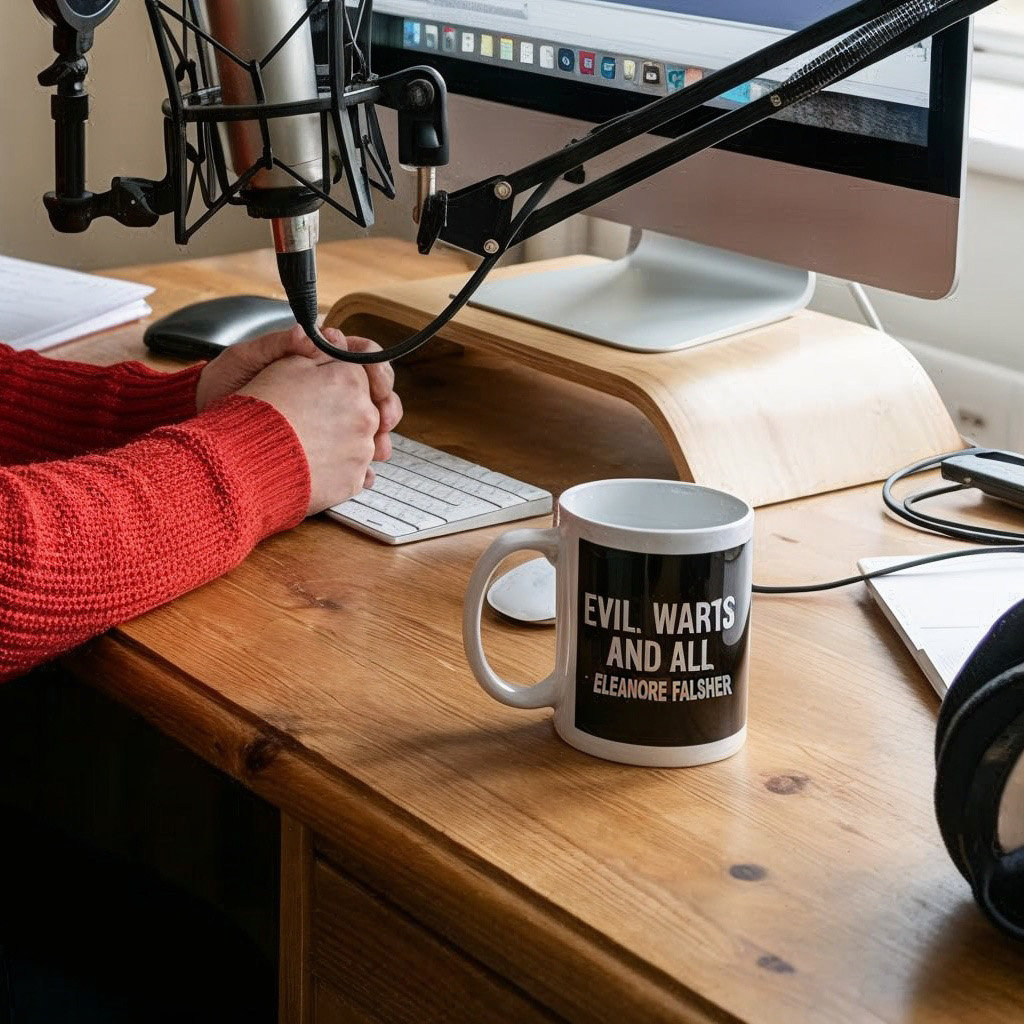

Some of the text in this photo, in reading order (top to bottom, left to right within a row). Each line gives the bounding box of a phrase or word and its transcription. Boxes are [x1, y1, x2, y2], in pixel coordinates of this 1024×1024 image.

[653, 595, 736, 635] WARTS
[606, 636, 715, 672] AND ALL
[593, 673, 733, 702] ELEANORE FALSHER
